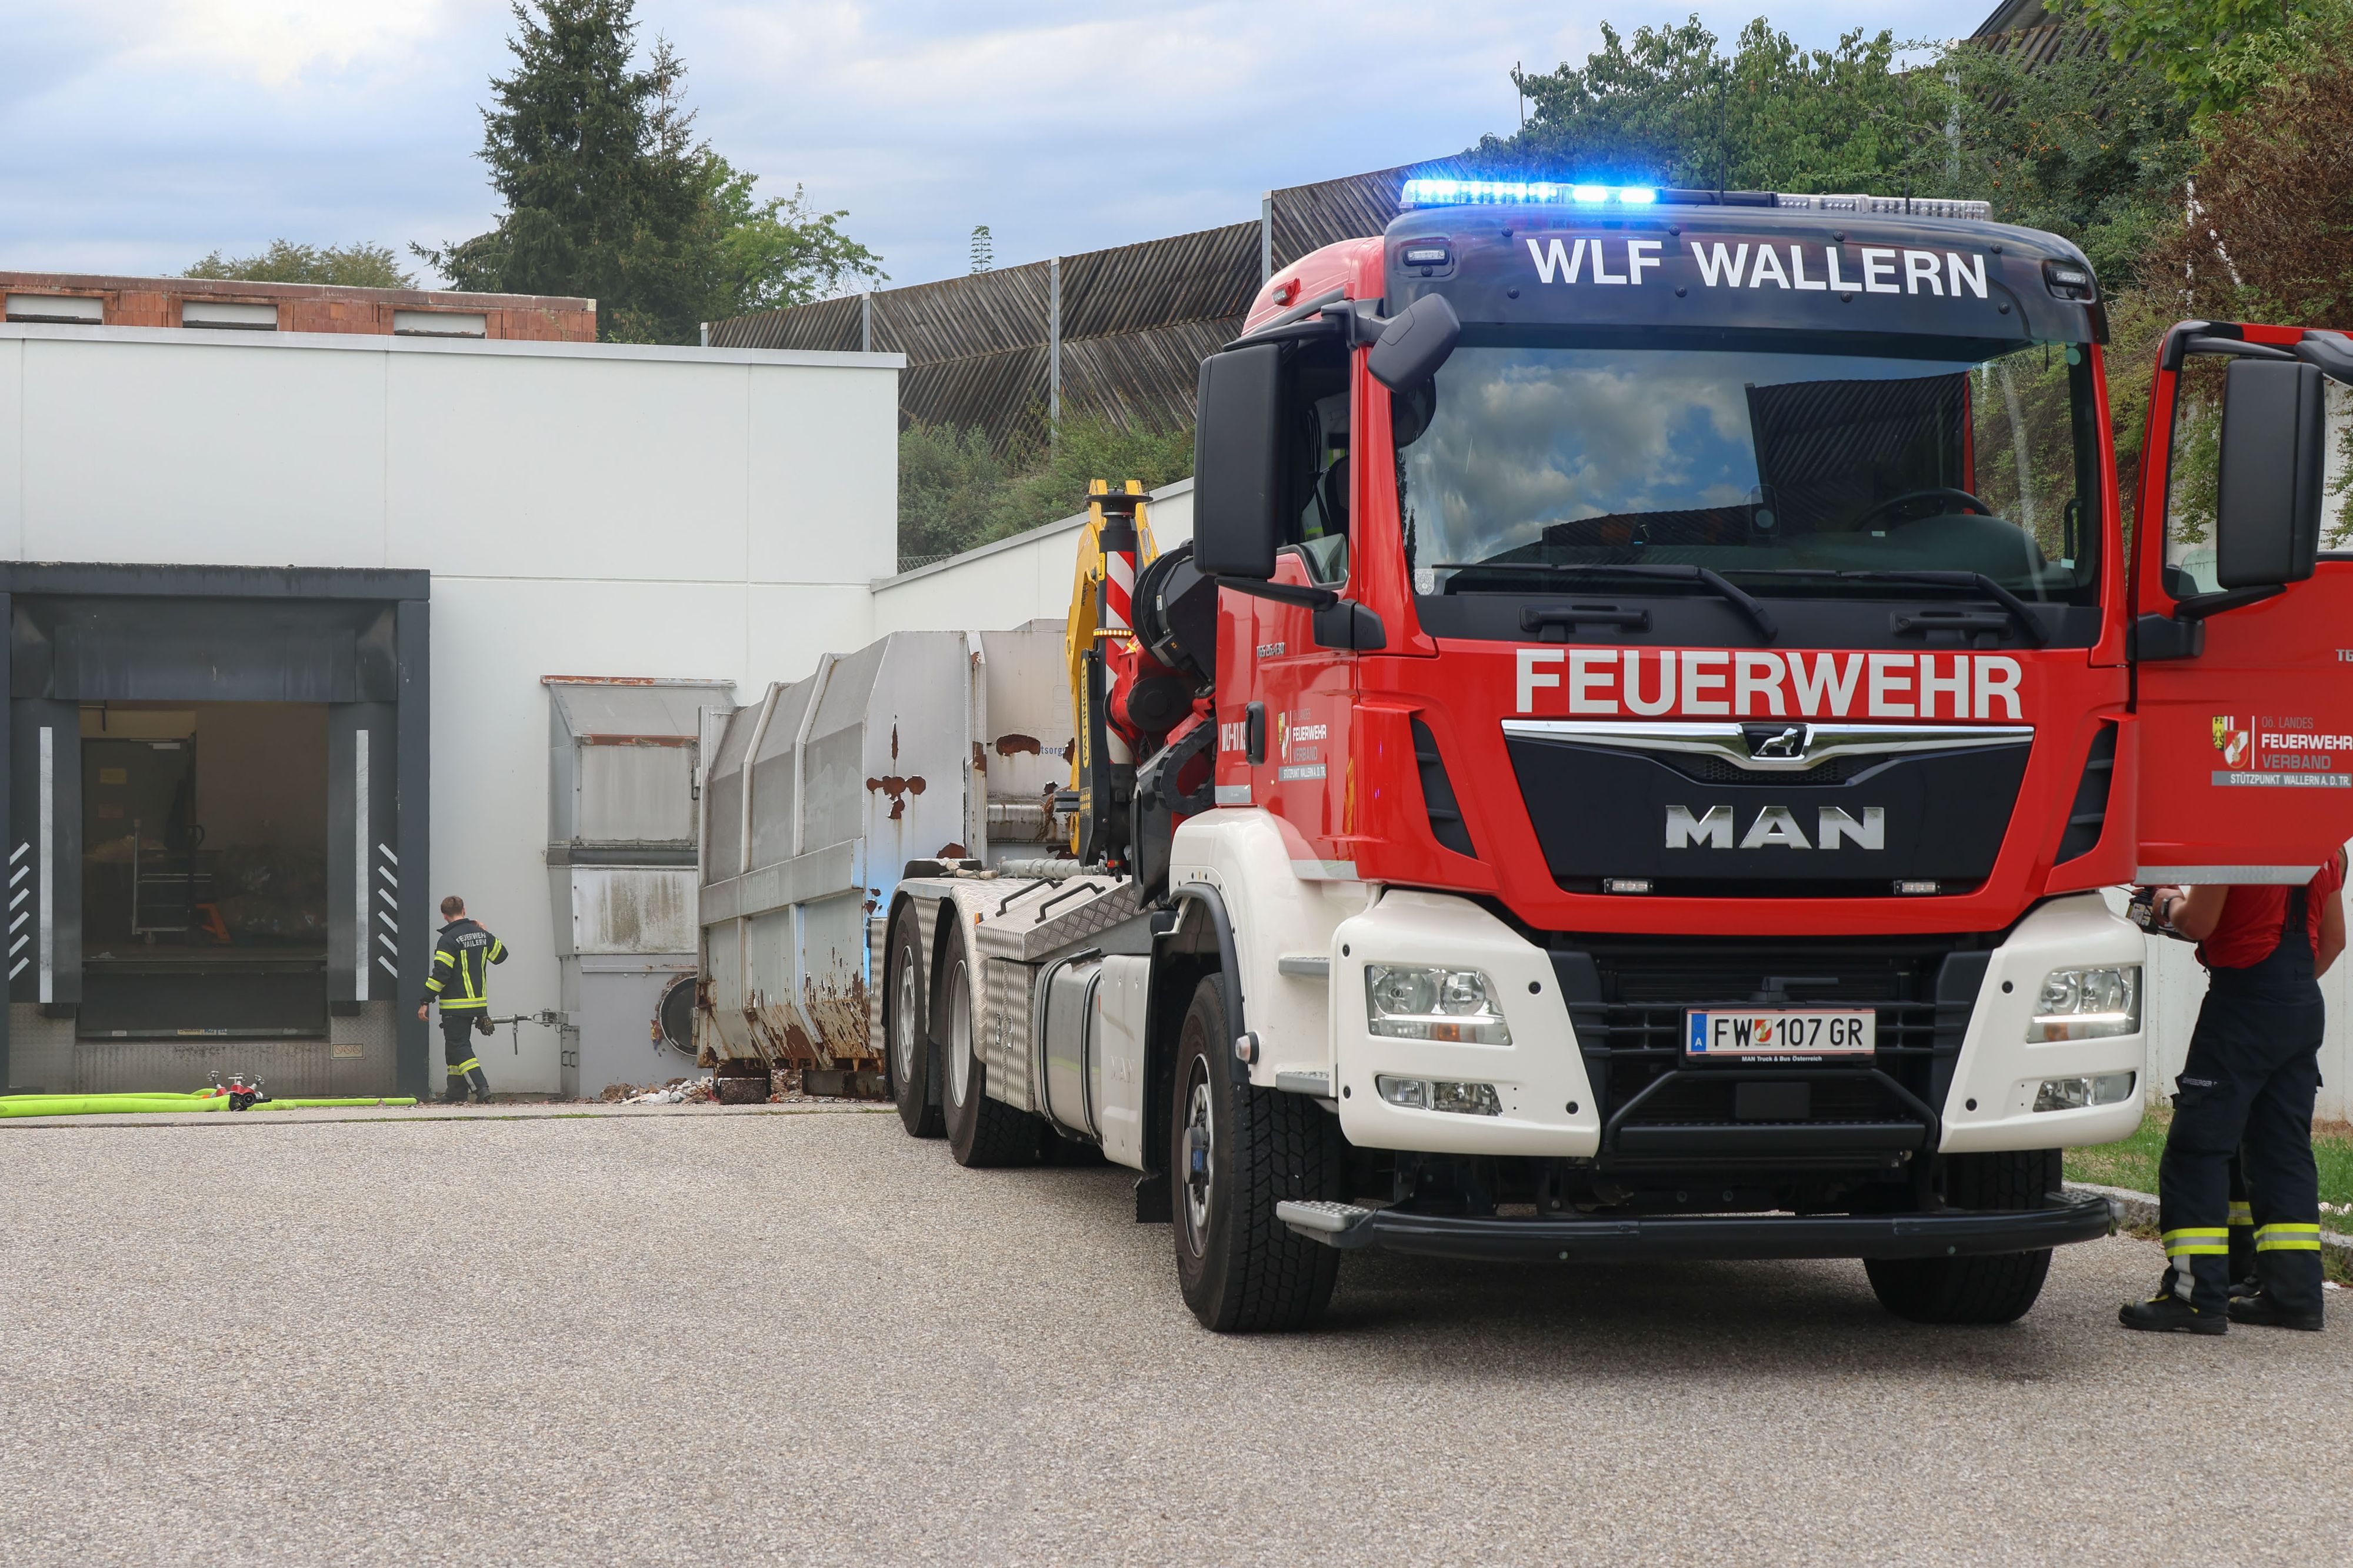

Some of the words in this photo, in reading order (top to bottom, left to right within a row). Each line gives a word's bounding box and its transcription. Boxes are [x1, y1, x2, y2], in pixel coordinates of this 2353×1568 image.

[1525, 238, 1662, 286] WLF
[1691, 242, 1989, 299] WALLERN
[1516, 648, 2024, 719] FEUERWEHR
[2278, 716, 2314, 729] LANDES
[1292, 724, 1327, 742] FEUERWEHR
[2261, 733, 2353, 750] FEUERWEHR
[1294, 746, 1318, 762] VERBAND
[2262, 753, 2331, 770] VERBAND
[2230, 772, 2280, 785] STÜTZPUNKT
[2284, 775, 2319, 785] WALLERN
[2330, 776, 2337, 786] D.
[2339, 776, 2351, 786] TR.
[1665, 805, 1885, 849] MAN
[1714, 1018, 1752, 1047] FW
[1775, 1018, 1822, 1047] 107
[1829, 1017, 1863, 1046] GR
[1695, 1037, 1702, 1046] A
